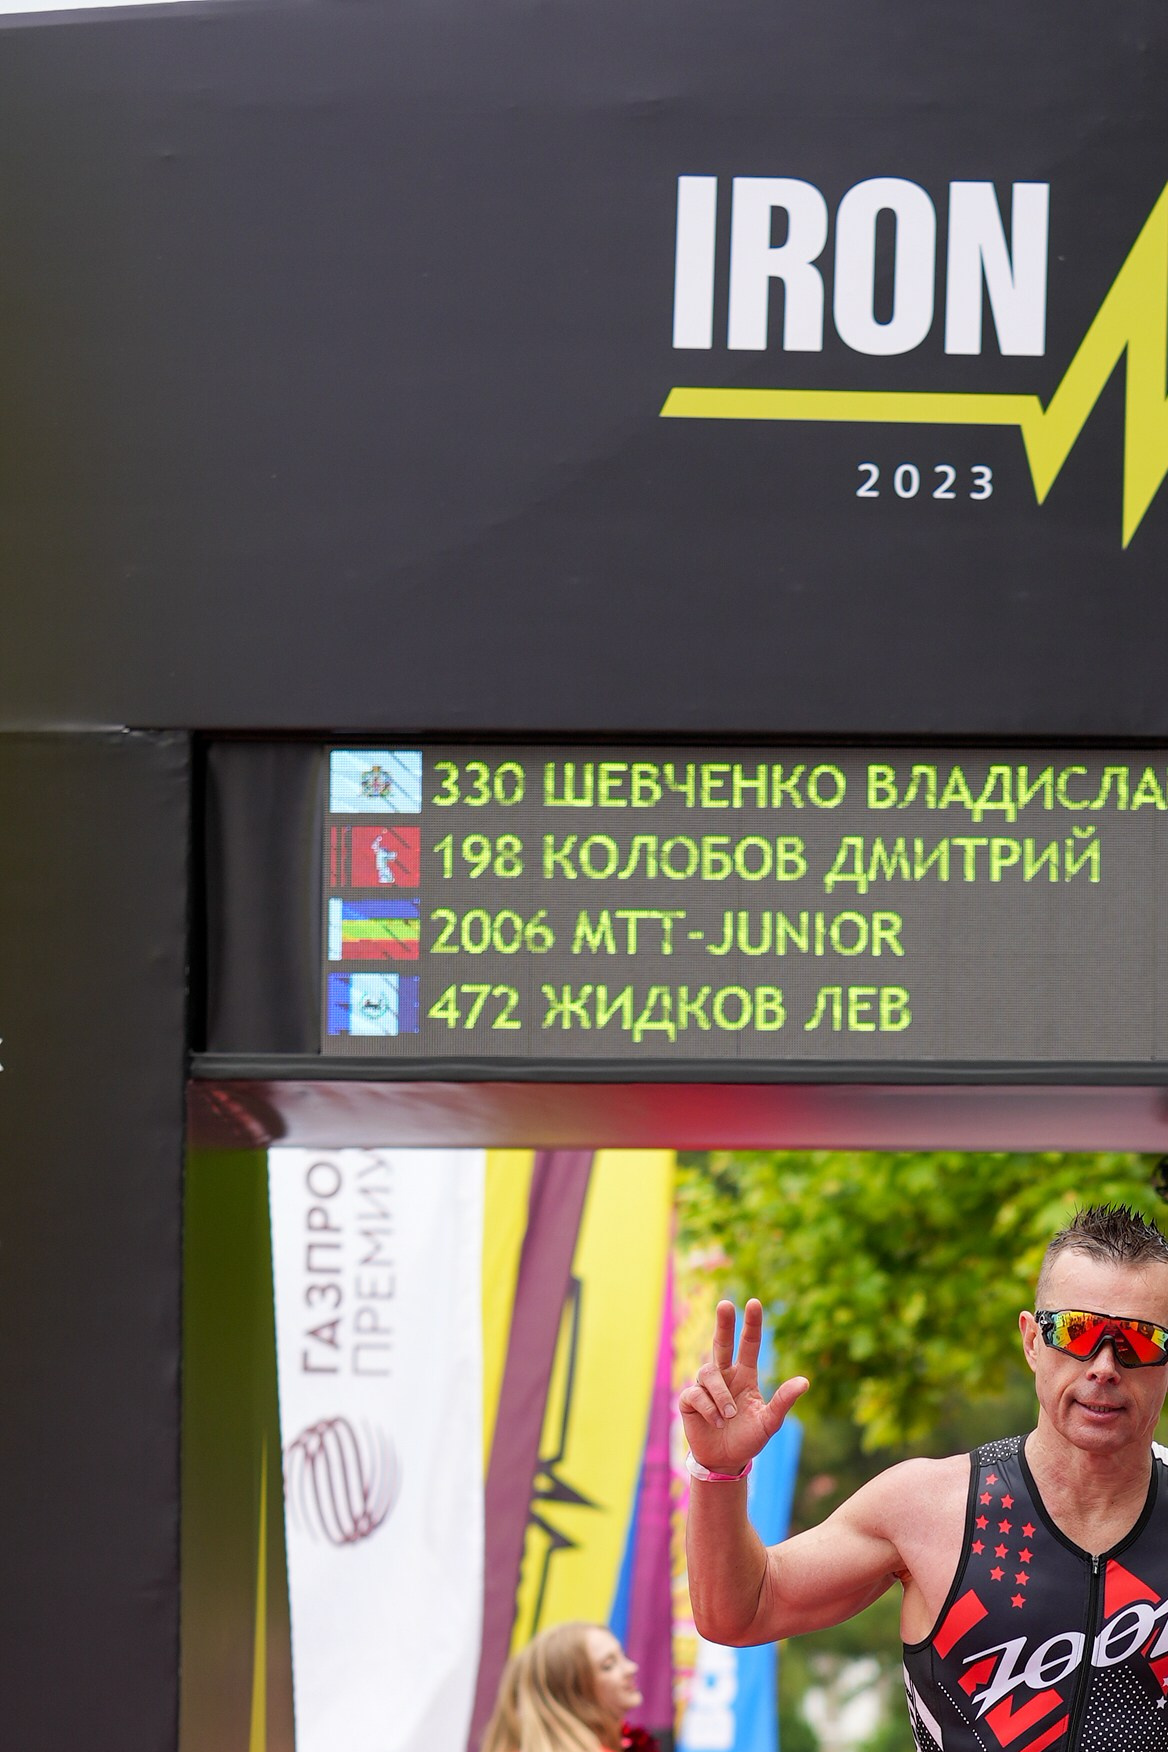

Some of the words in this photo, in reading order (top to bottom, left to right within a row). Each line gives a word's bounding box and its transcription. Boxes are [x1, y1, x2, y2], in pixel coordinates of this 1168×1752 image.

[672, 176, 1049, 356] IRON
[856, 463, 995, 500] 2023
[431, 761, 526, 807] 330
[543, 761, 847, 809] ШЕВЧЕНКО
[432, 832, 525, 878] 198
[542, 832, 809, 881] КОЛОБОВ
[822, 827, 1102, 894] ДМИТРИЙ
[429, 906, 556, 955] 2006
[571, 907, 905, 957] MTT-JUNIOR
[427, 982, 523, 1031] 472
[541, 982, 788, 1043] ЖИДКОВ
[803, 984, 913, 1033] ЛЕВ
[302, 1148, 343, 1374] ГАЗПРО
